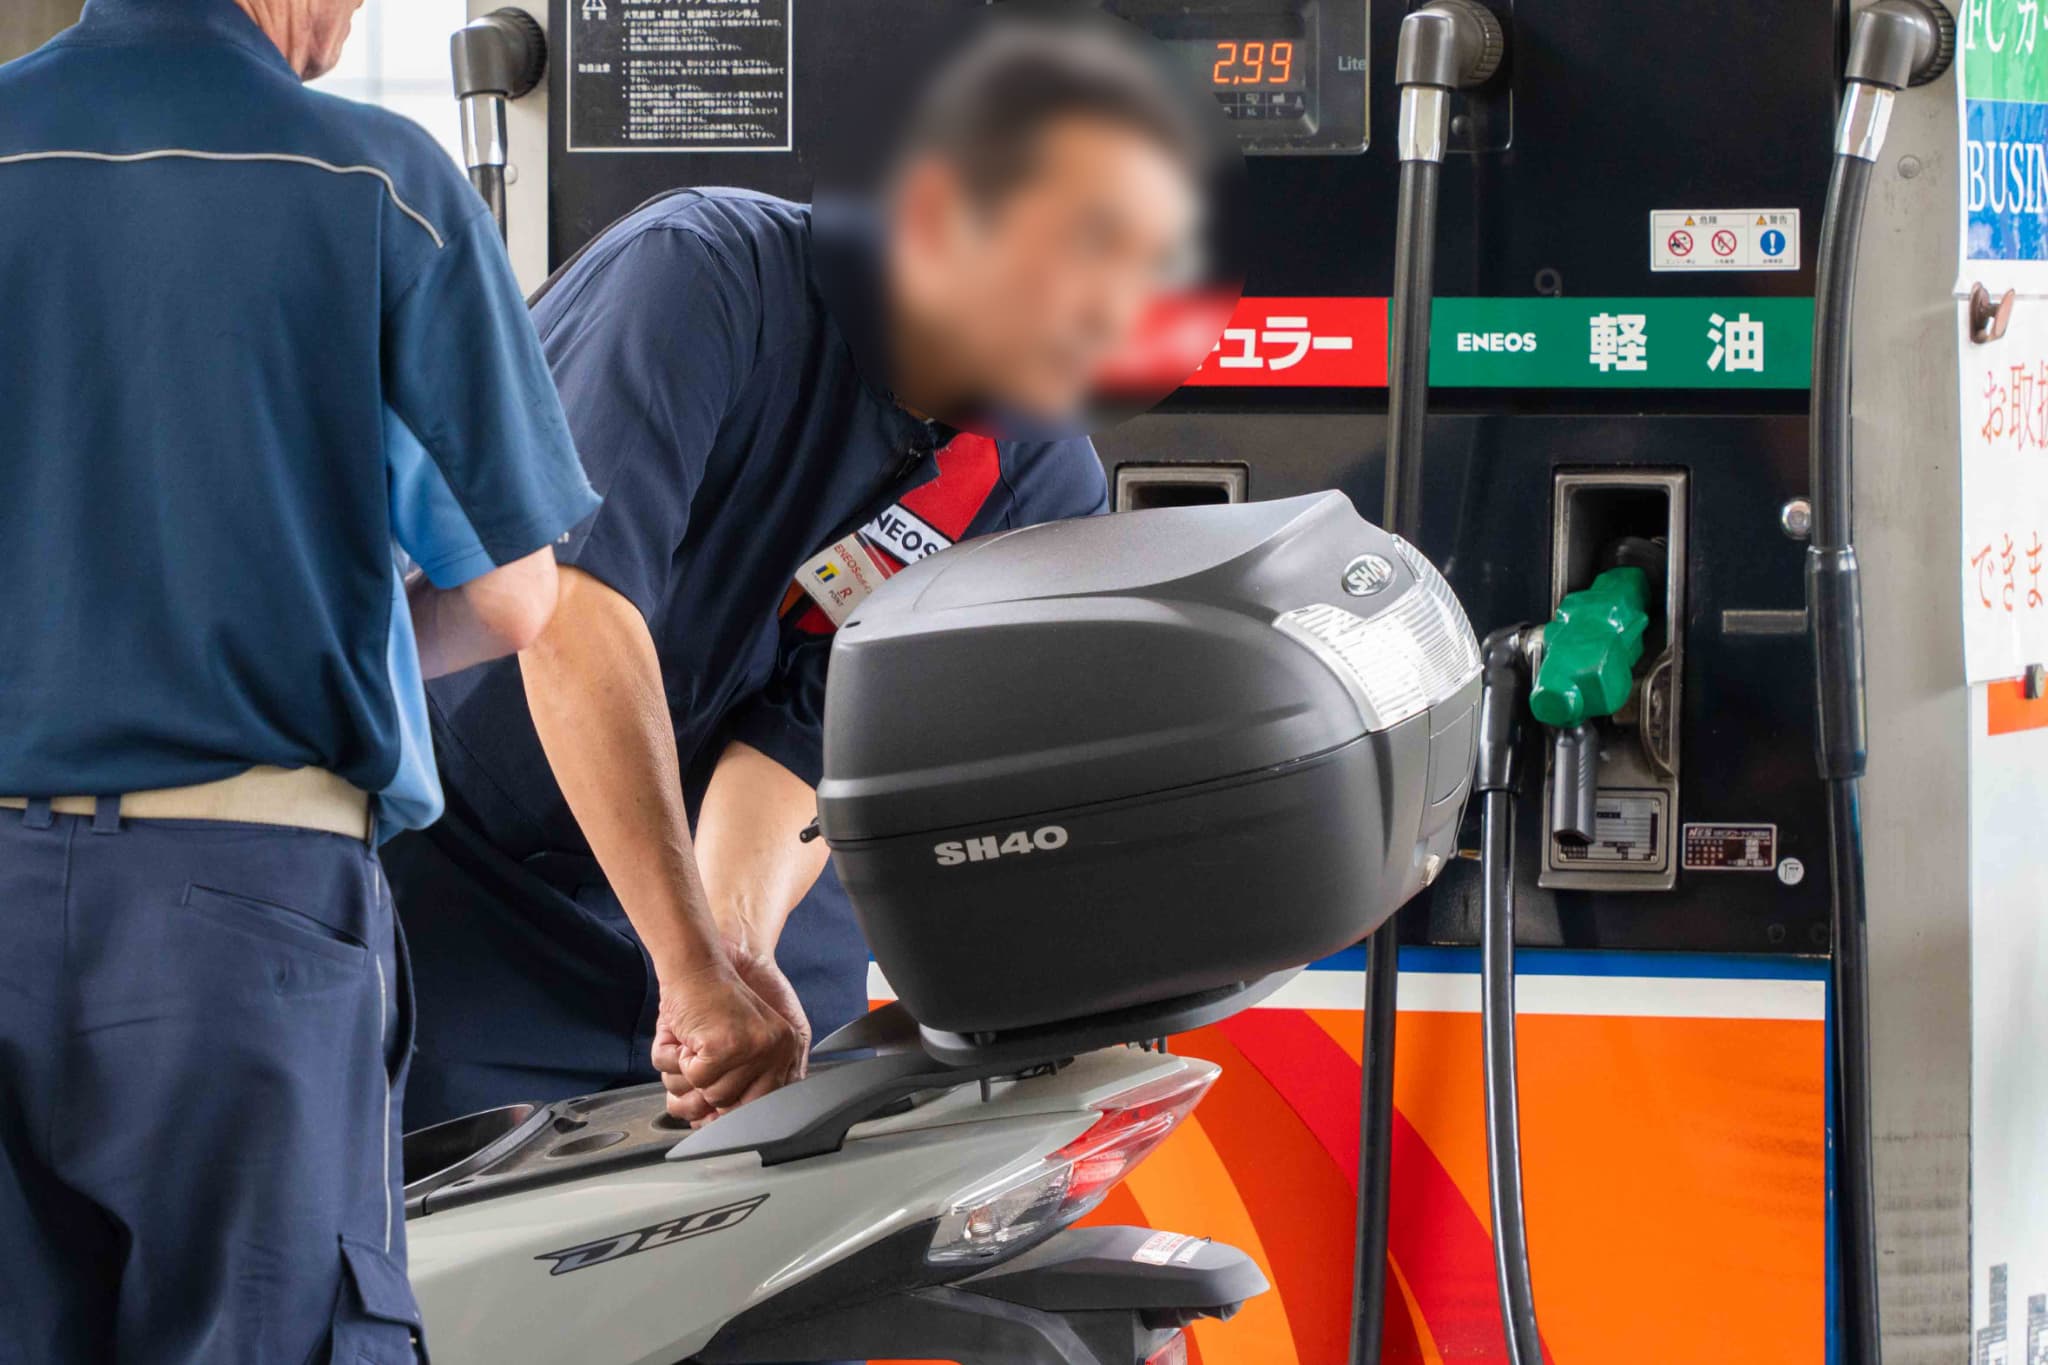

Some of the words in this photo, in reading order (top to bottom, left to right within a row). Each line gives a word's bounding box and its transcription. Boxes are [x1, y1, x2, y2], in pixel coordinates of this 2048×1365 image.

[1197, 316, 1353, 371] ュラー
[1457, 332, 1537, 352] ENEOS
[1590, 312, 1764, 372] 軽油
[934, 825, 1068, 866] SH40
